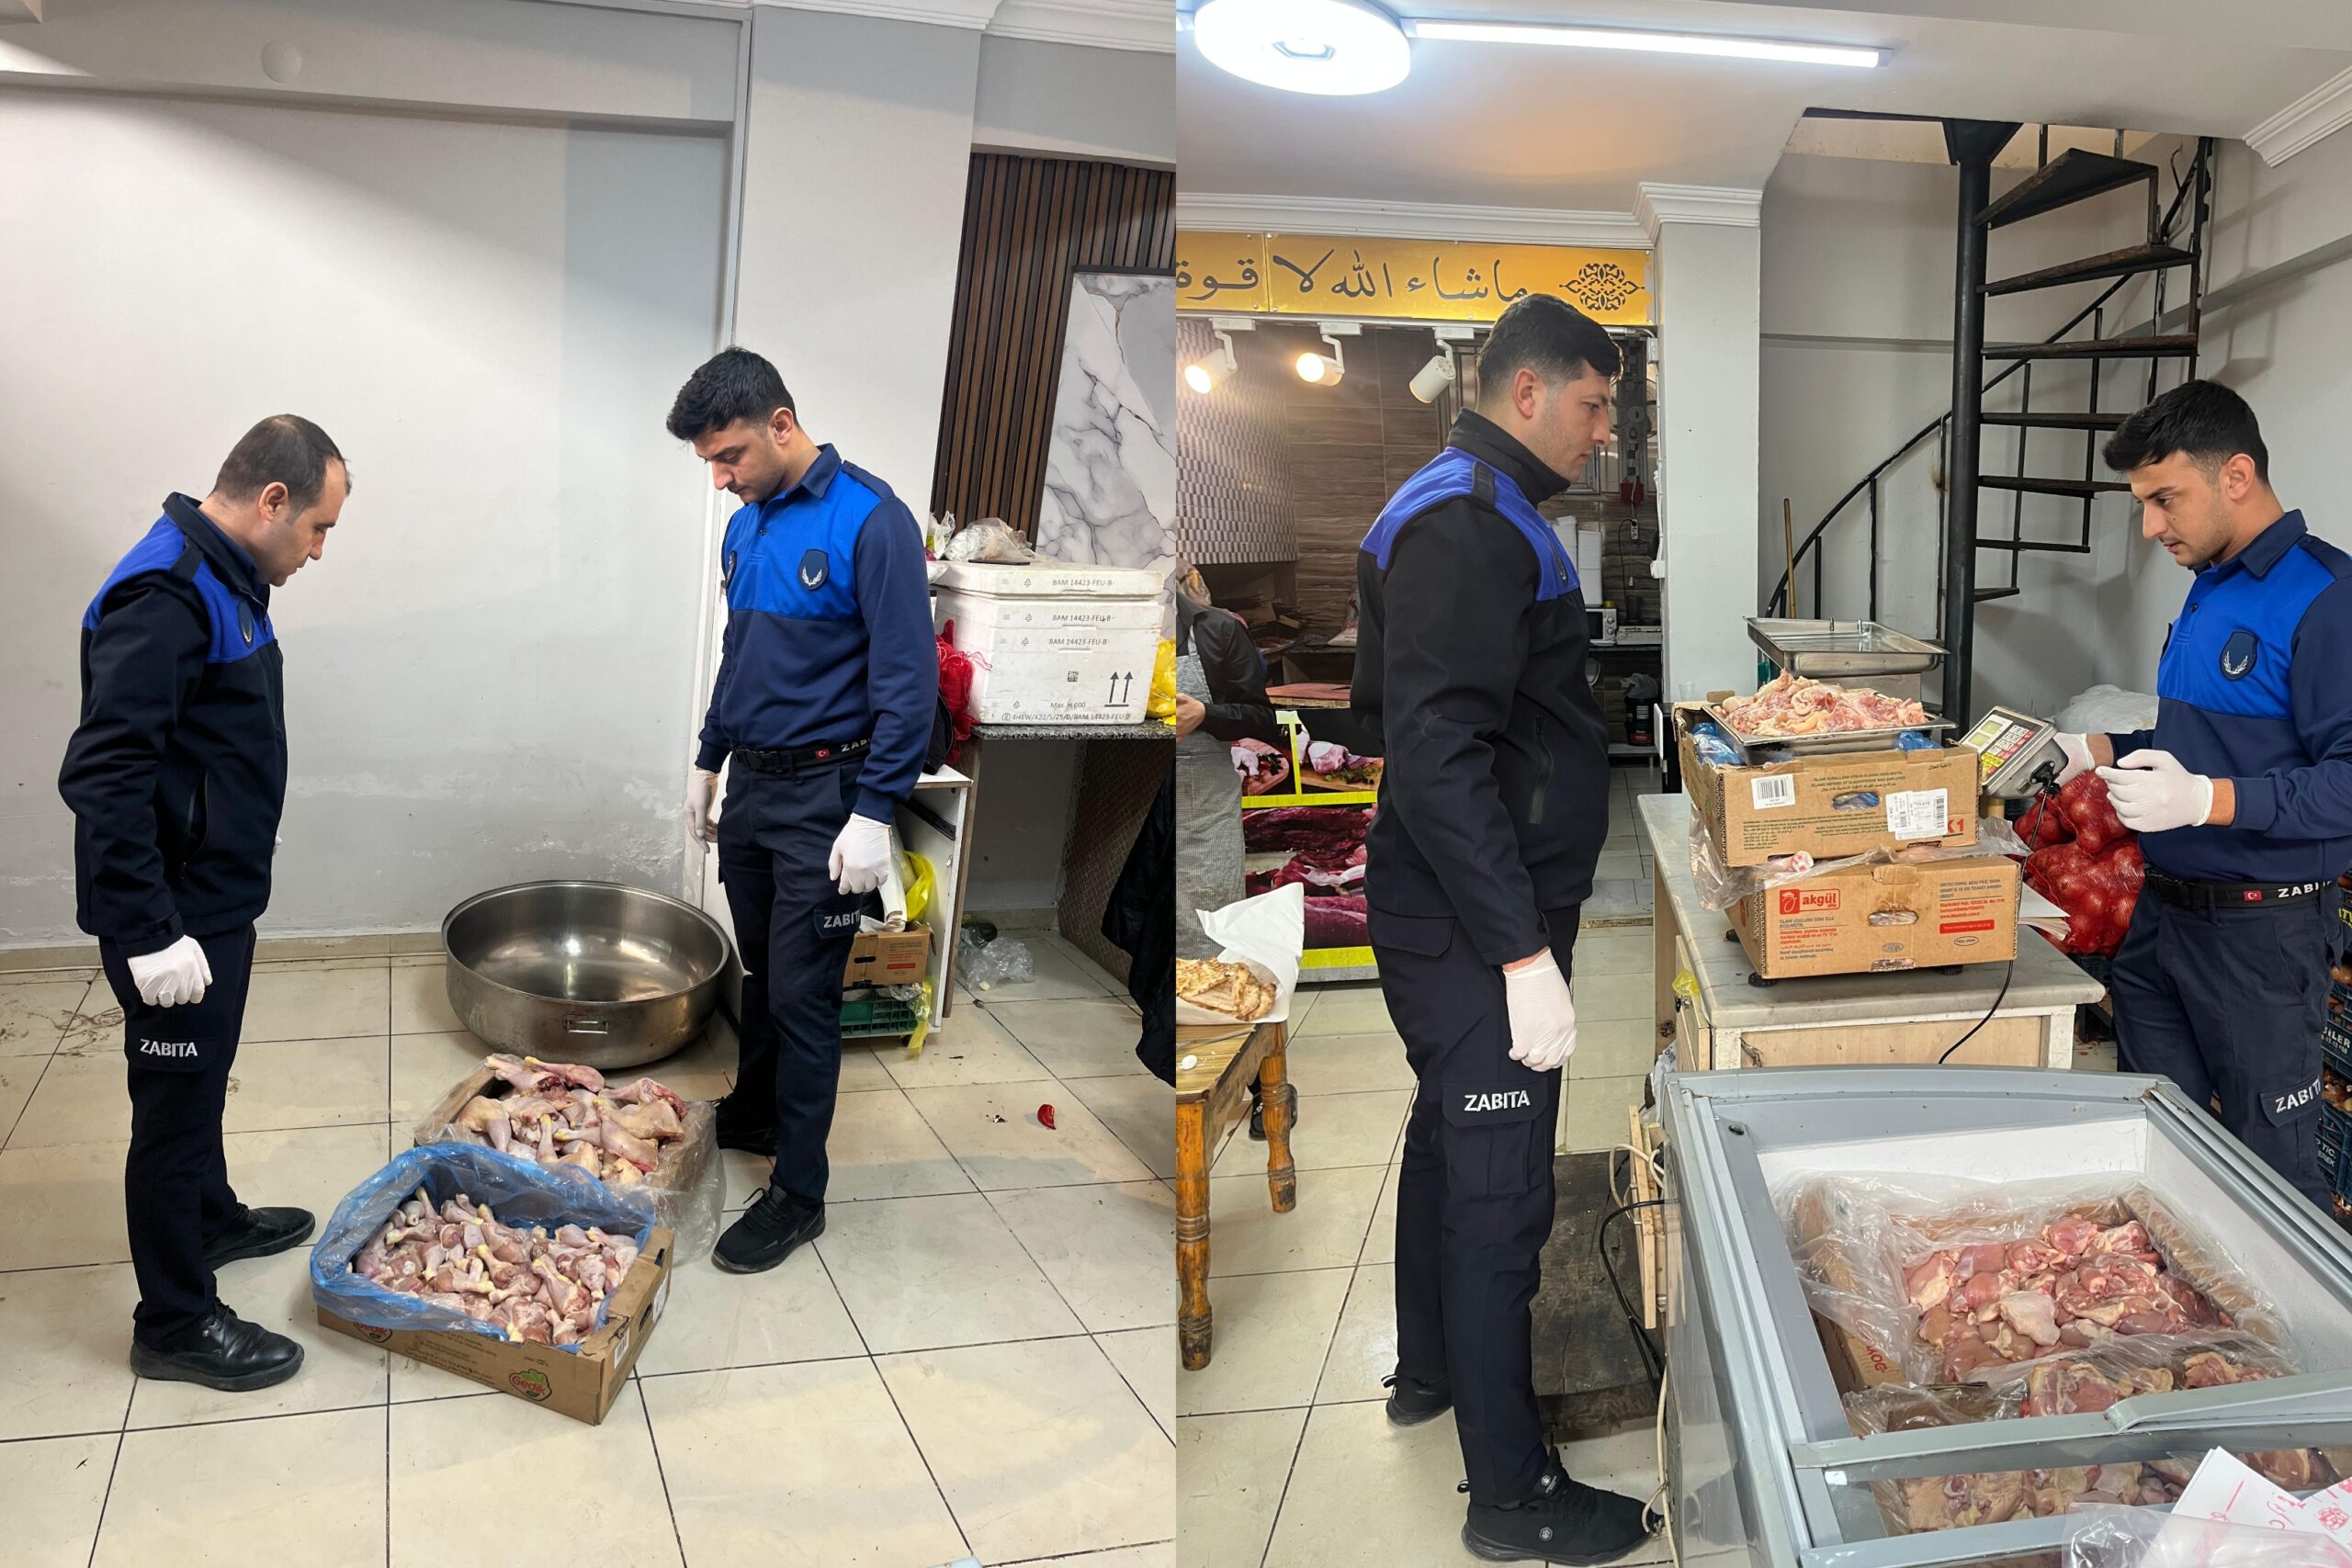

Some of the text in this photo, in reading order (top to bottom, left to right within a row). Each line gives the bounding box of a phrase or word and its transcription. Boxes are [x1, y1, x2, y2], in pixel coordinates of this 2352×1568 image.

[1176, 258, 1259, 300] قوة
[1272, 248, 1336, 293] لا
[1329, 249, 1393, 299] الله
[841, 738, 870, 752] ZAB
[1803, 893, 1837, 907] akgül
[140, 1038, 198, 1057] ZABITA
[1464, 1089, 1531, 1112] ZABITA
[512, 1375, 547, 1396] Gedik
